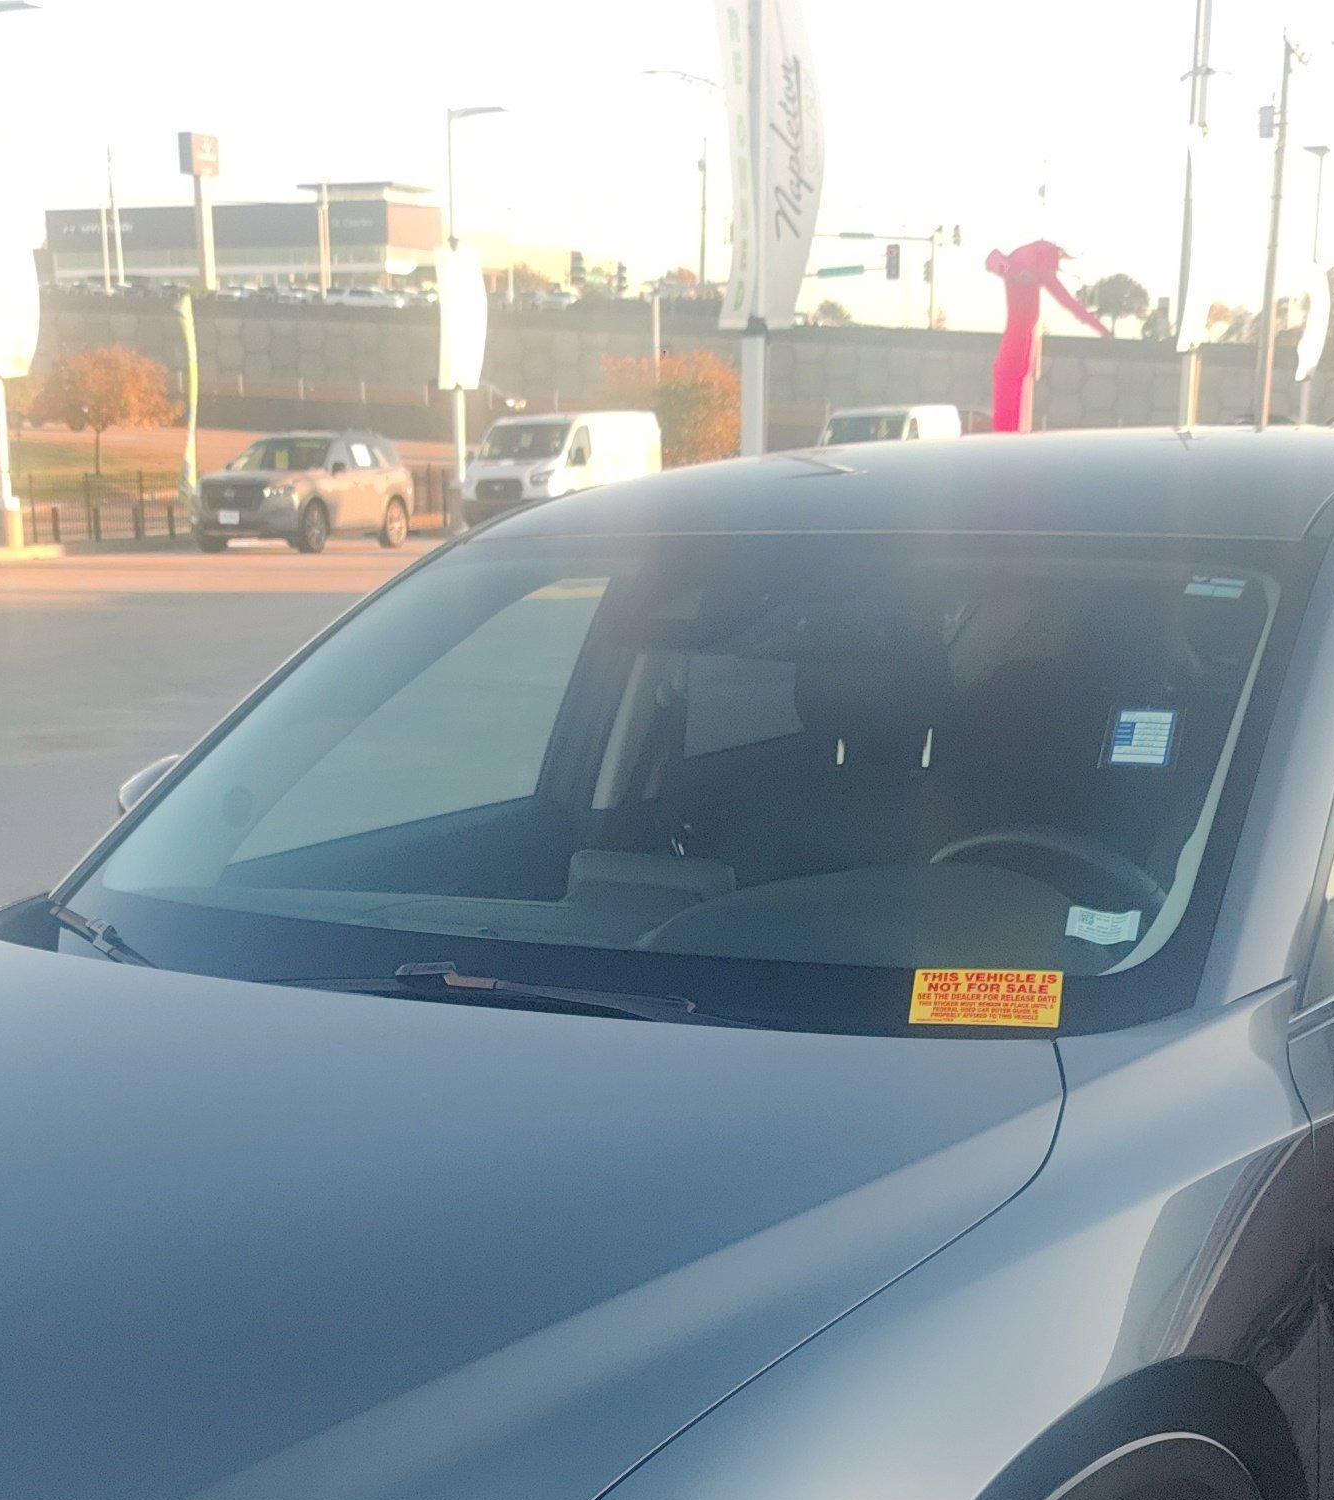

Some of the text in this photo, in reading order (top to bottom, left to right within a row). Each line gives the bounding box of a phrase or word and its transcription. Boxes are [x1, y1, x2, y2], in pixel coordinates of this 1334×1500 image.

[769, 55, 815, 241] Napleton
[922, 972, 1057, 984] THIS VEHICLE IS
[928, 983, 1049, 994] NOT FOR SALE
[1001, 994, 1035, 1002] RELEASE
